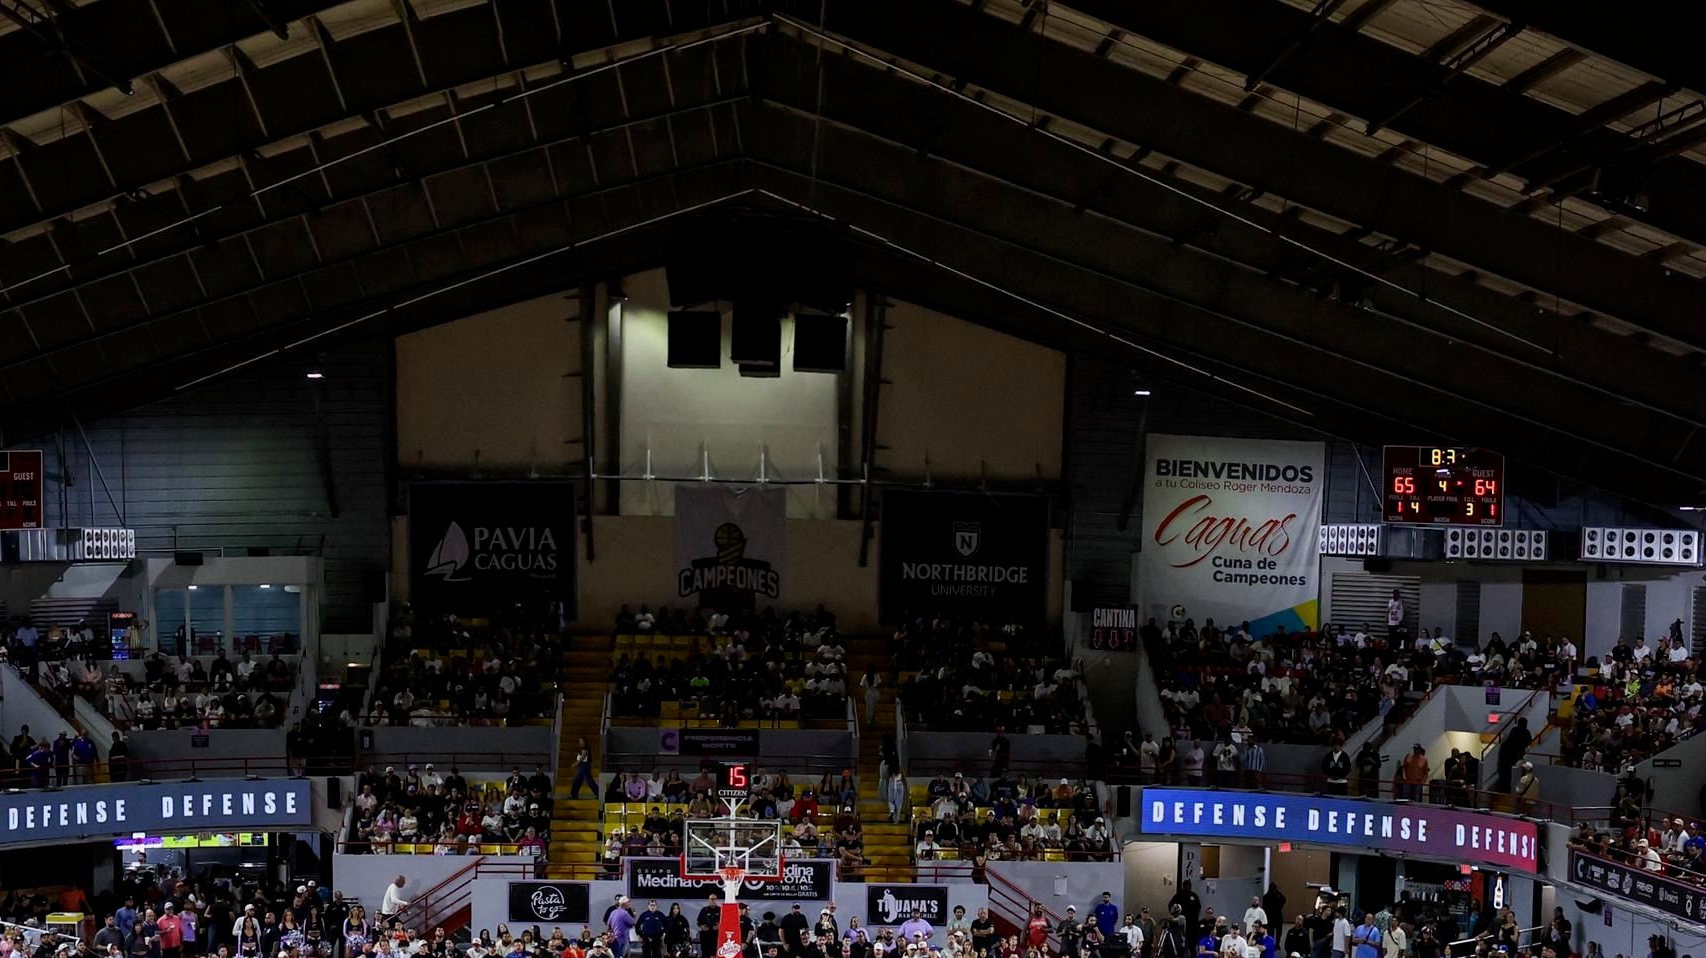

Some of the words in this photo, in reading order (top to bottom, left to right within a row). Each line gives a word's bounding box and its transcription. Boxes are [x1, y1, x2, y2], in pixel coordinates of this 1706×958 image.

[13, 472, 35, 480] GUEST
[1156, 459, 1314, 483] BIENVENIDOS
[1165, 479, 1178, 488] tu
[1180, 479, 1222, 490] Coliseo
[1223, 480, 1258, 494] Roger
[1260, 481, 1311, 494] Mendoza
[1394, 477, 1416, 494] 65
[1475, 479, 1496, 495] 64
[1438, 480, 1447, 492] 4
[1411, 501, 1419, 514] 4
[1466, 503, 1474, 516] 3
[474, 527, 558, 551] PAVIA
[1154, 494, 1297, 568] Caguas
[474, 552, 558, 571] CAGUAS
[1212, 555, 1253, 569] Cuna
[1256, 557, 1277, 570] de
[679, 565, 780, 598] CAMPEONES
[902, 563, 1030, 584] NORTHBRIDGE
[1213, 571, 1306, 587] Campeones
[931, 583, 998, 599] UNIVERSITY
[1093, 607, 1135, 628] CANTINA
[729, 766, 746, 787] 15
[717, 789, 748, 797] CITIZEN
[8, 799, 127, 831] DEFENSE
[161, 791, 296, 819] DEFENSE
[1152, 800, 1286, 829] DEFENSE
[1307, 809, 1428, 843] DEFENSE
[780, 876, 814, 884] OTAL
[531, 890, 562, 907] Pasta
